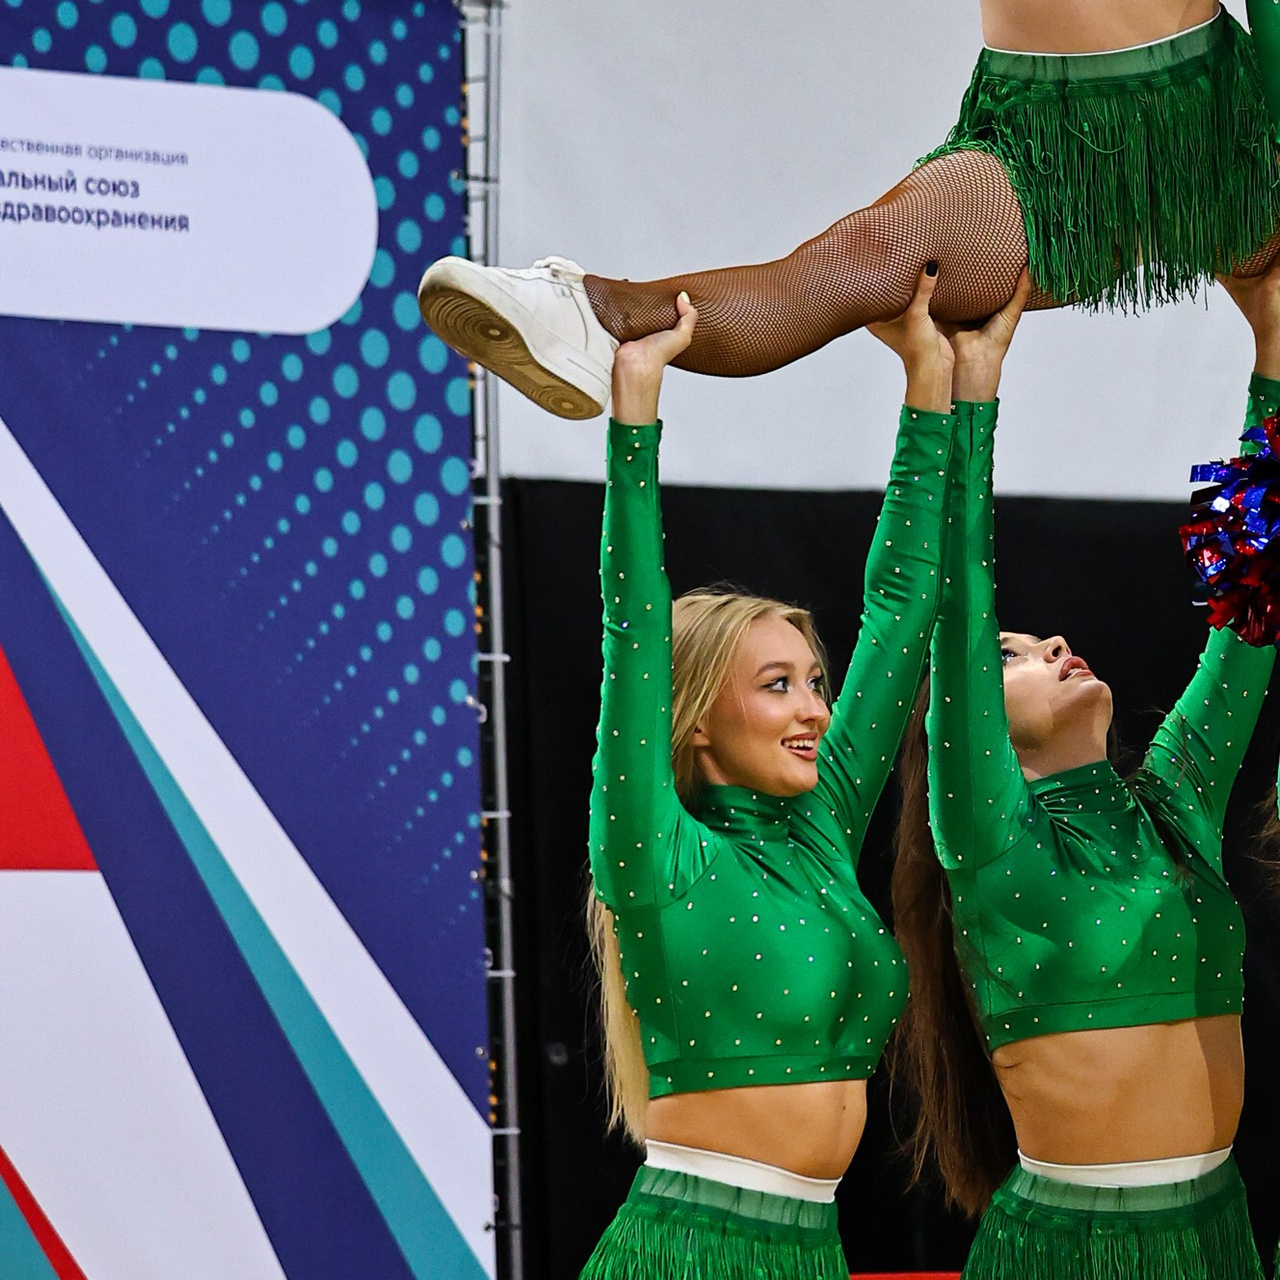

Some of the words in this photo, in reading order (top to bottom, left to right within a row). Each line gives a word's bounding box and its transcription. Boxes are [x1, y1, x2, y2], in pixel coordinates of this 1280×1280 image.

[87, 144, 190, 166] организация
[85, 176, 140, 199] союз
[0, 200, 190, 232] дравоохранения
